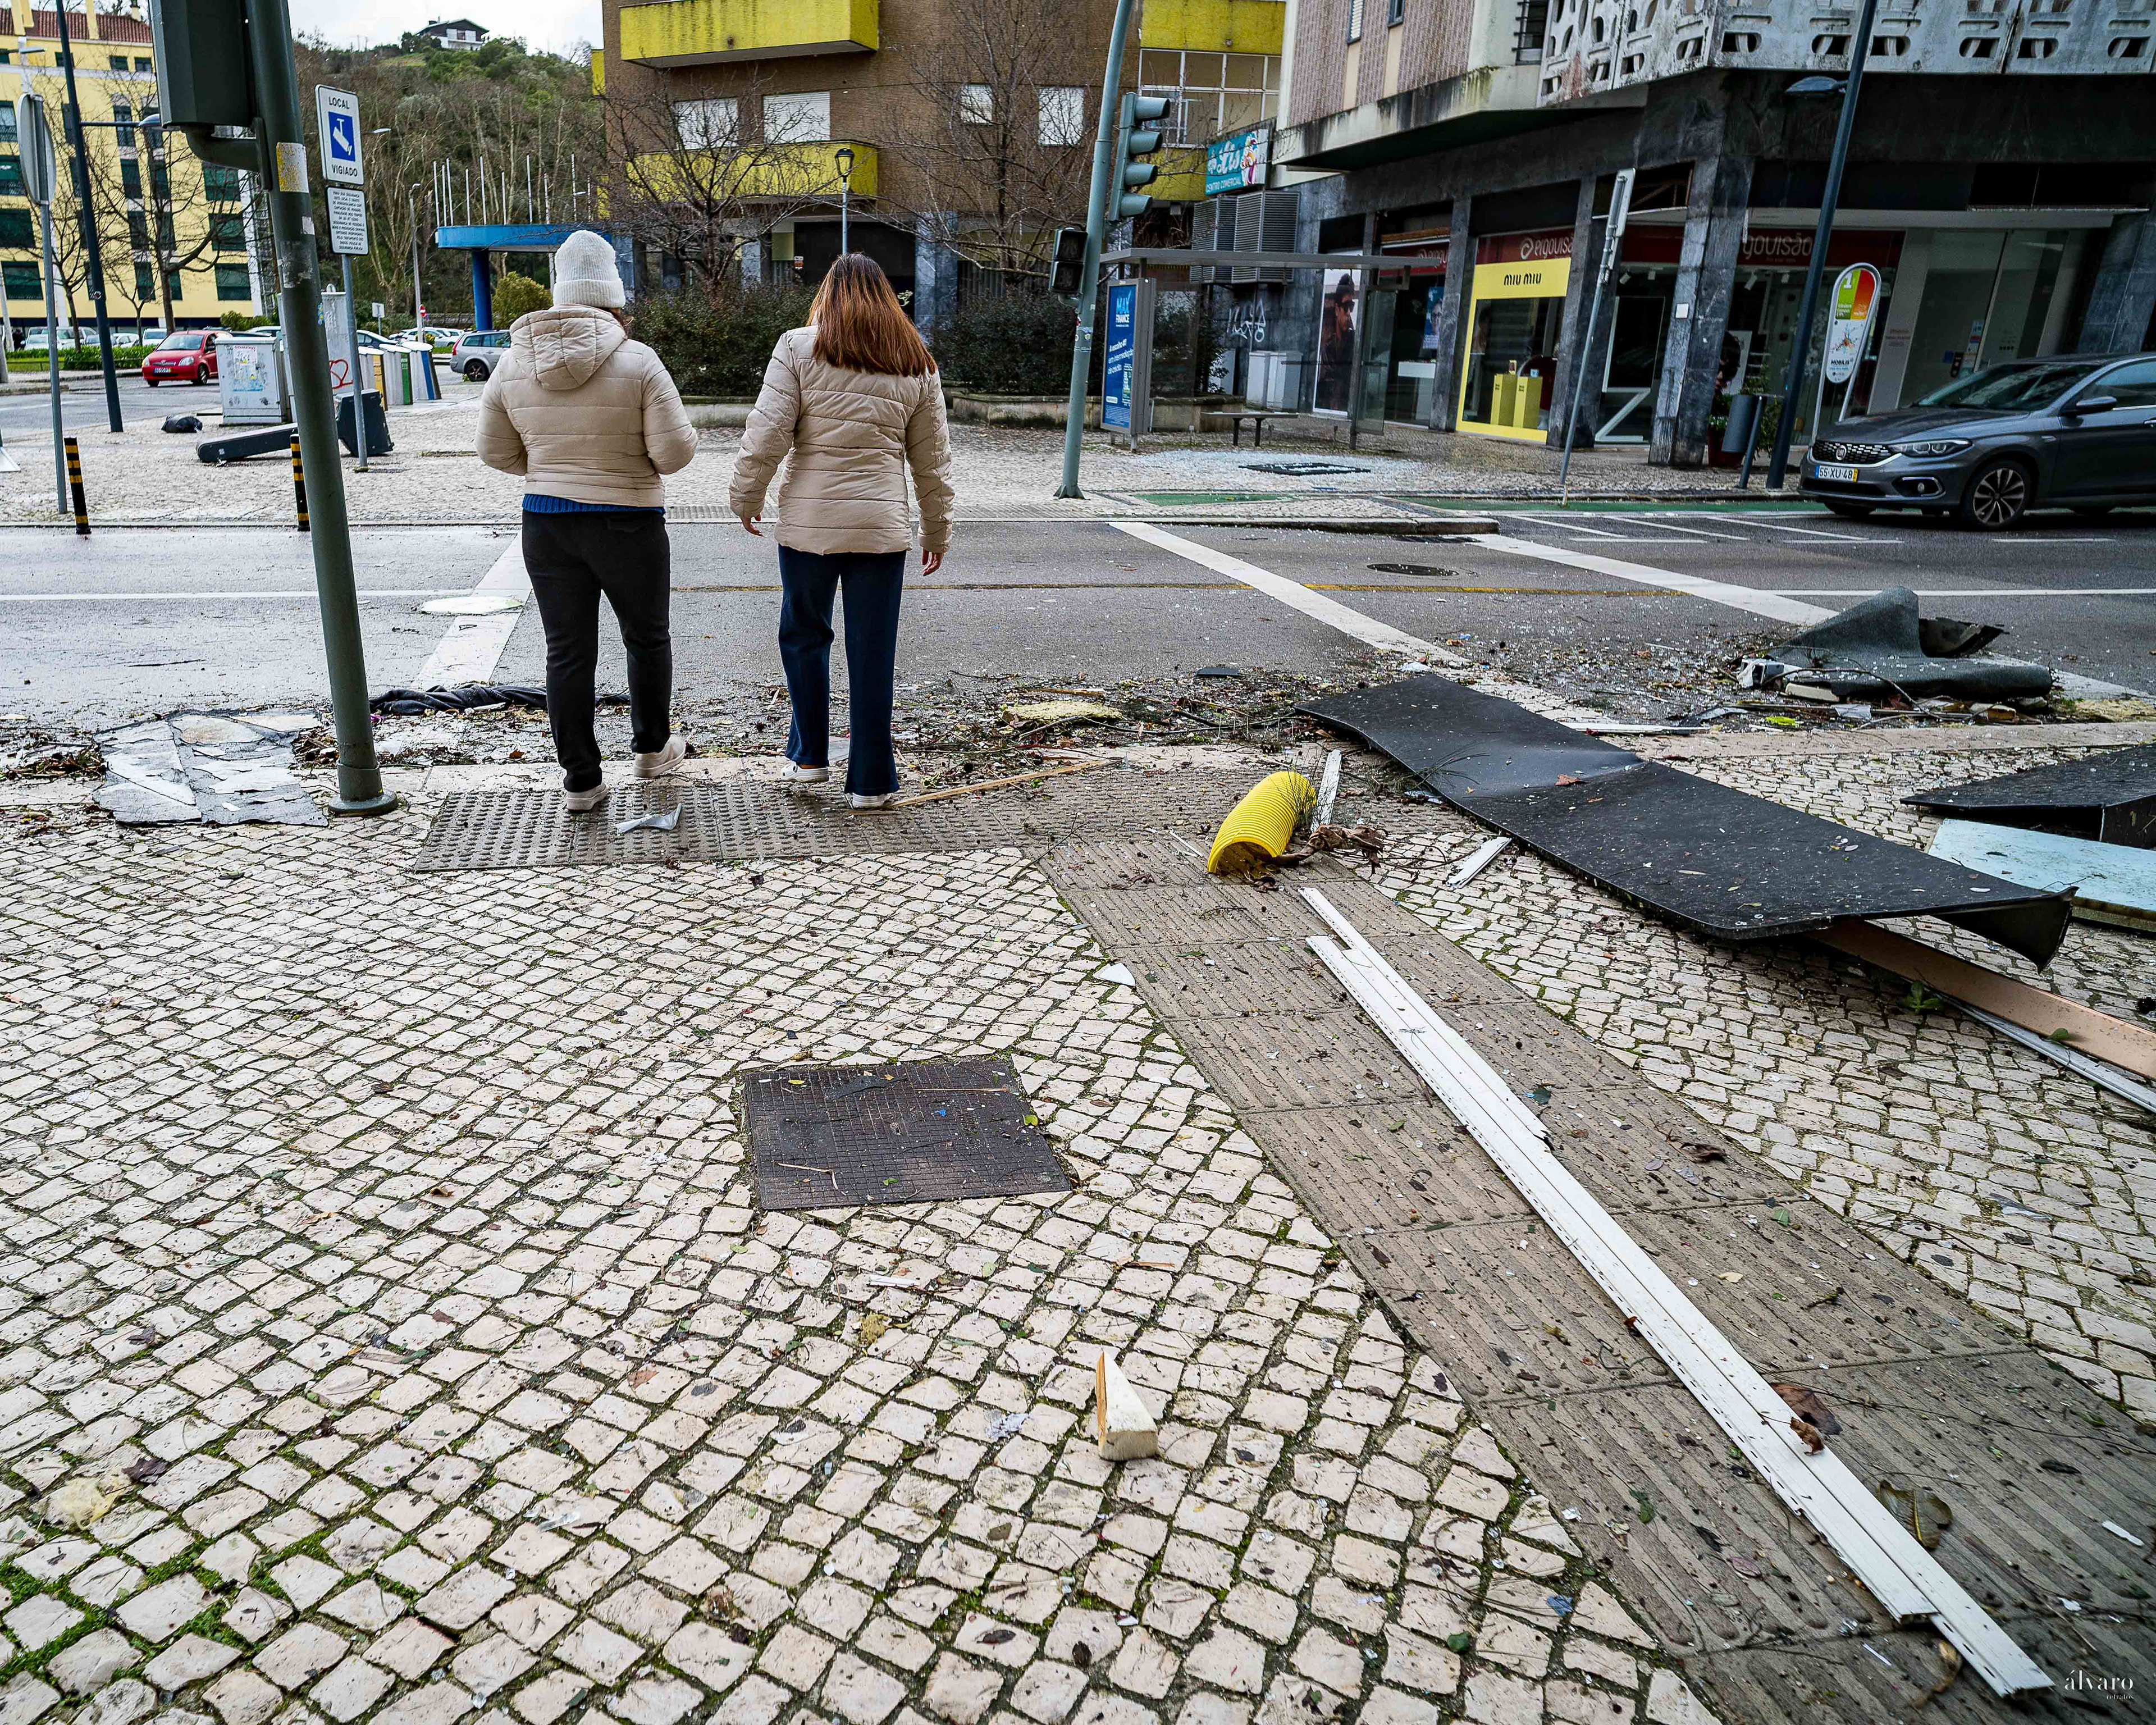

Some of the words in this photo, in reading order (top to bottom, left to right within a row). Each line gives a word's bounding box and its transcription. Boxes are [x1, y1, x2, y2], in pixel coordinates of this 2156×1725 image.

[328, 97, 350, 109] LOCAL
[332, 164, 358, 177] VIGIADO
[1842, 272, 1853, 288] 1
[1116, 291, 1131, 314] MAX
